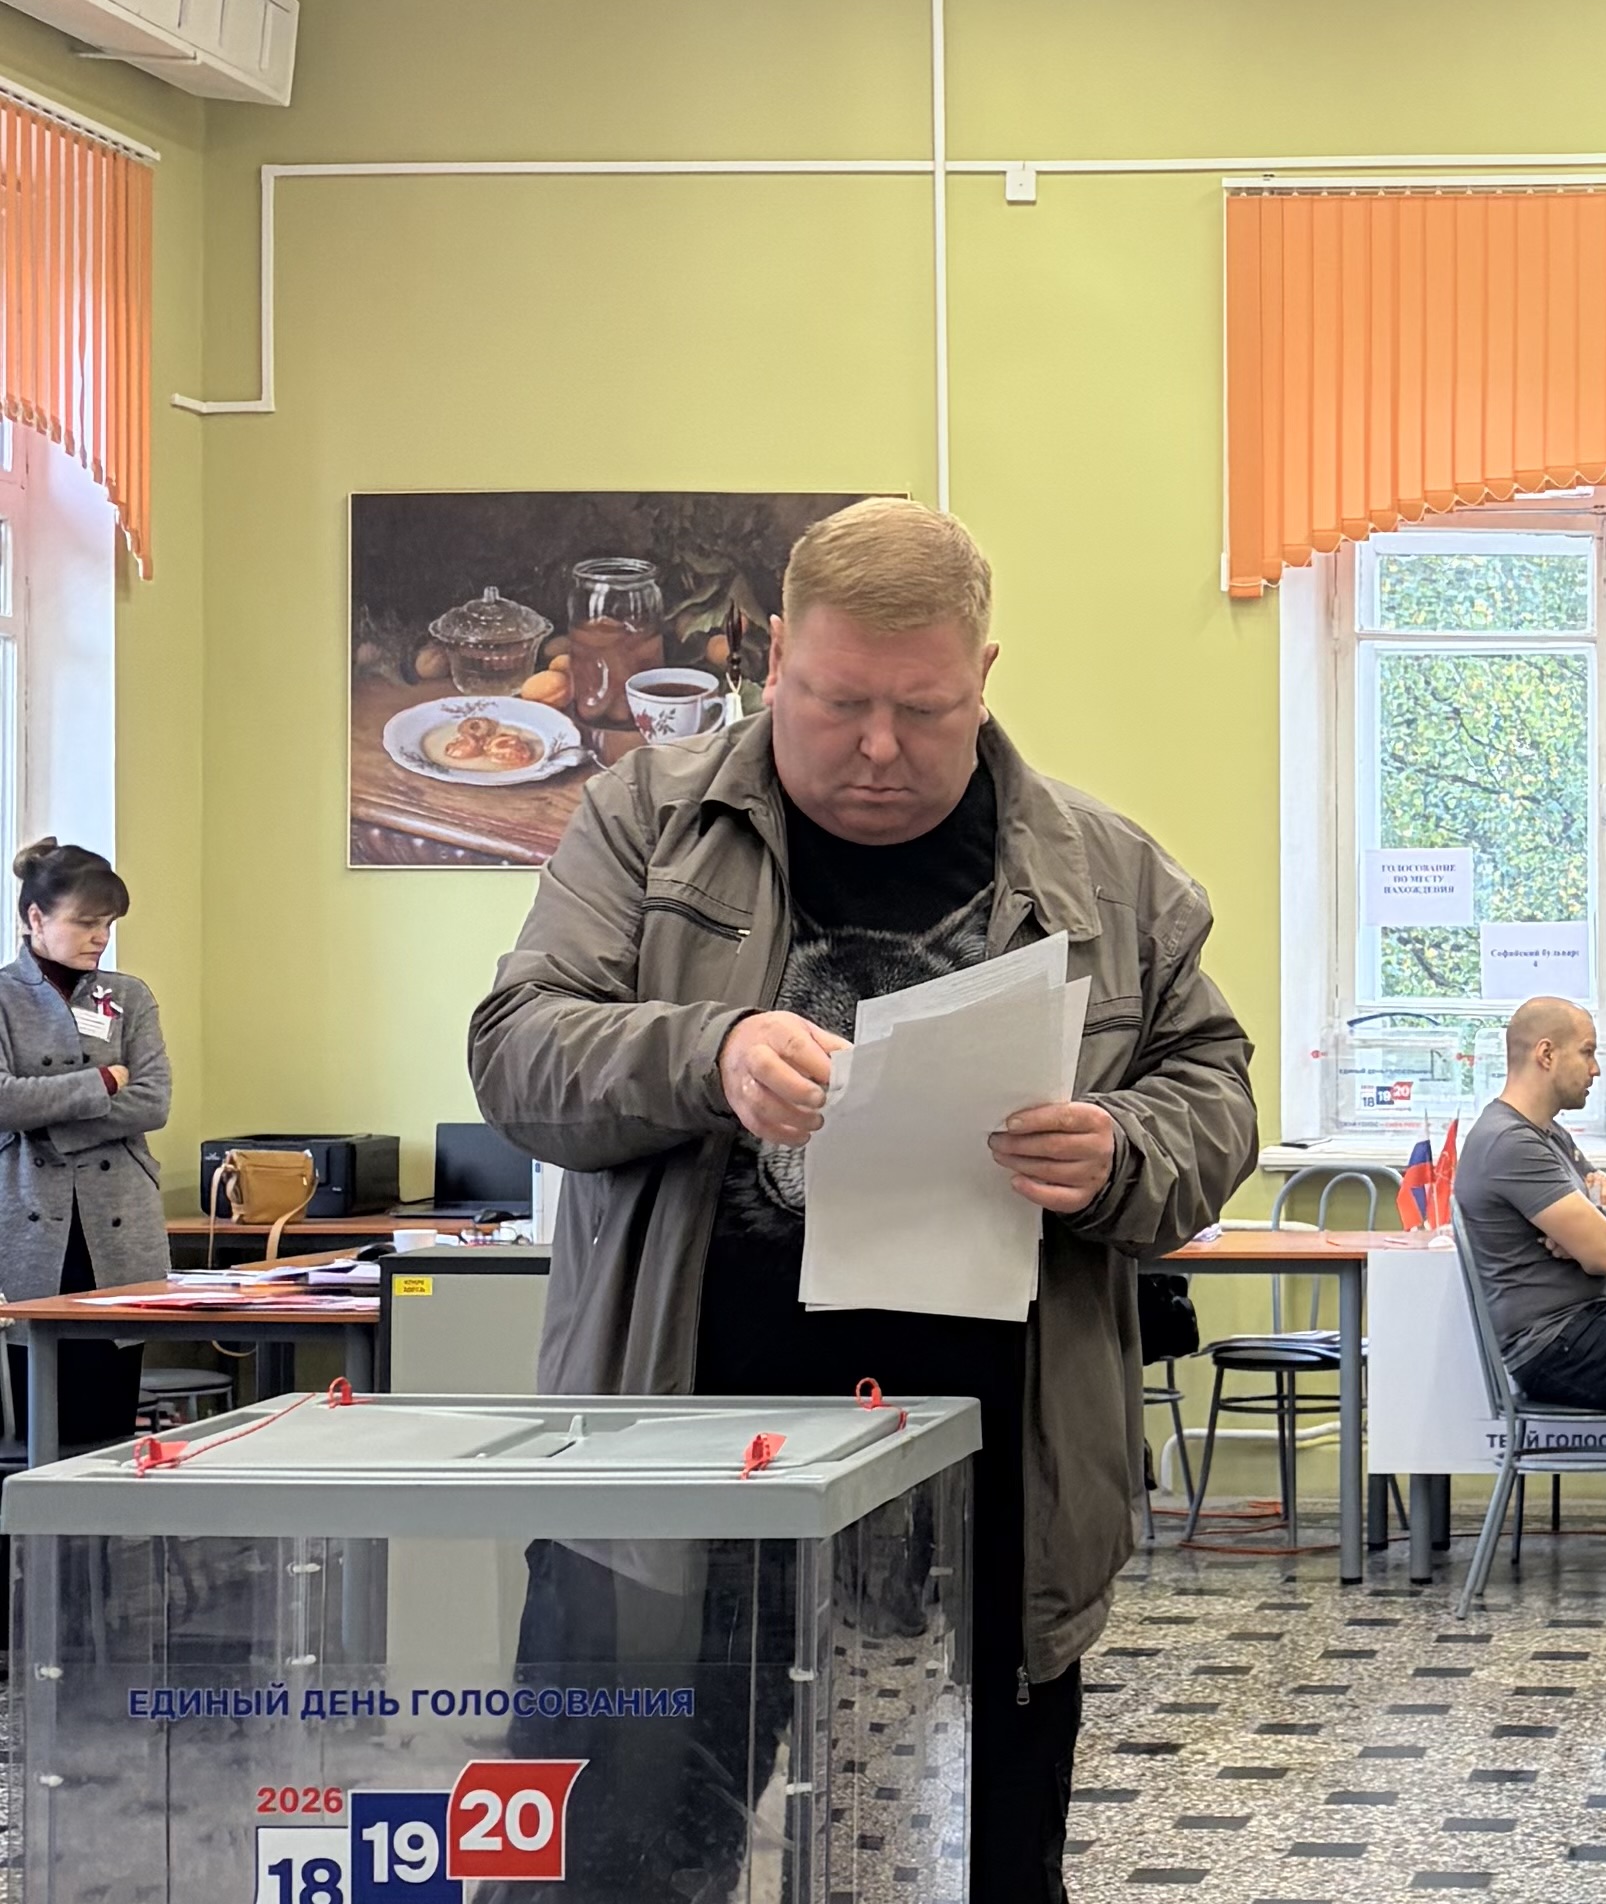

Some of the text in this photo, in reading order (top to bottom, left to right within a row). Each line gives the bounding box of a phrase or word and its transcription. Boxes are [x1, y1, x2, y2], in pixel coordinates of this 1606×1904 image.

[1363, 1097, 1375, 1107] 18
[1393, 1085, 1410, 1097] 20
[130, 1682, 694, 1720] ЕДИНЫЙ ДЕНЬ ГОЛОСОВАНИЯ
[257, 1787, 343, 1813] 2026
[362, 1821, 439, 1883] 19
[459, 1789, 554, 1851] 20
